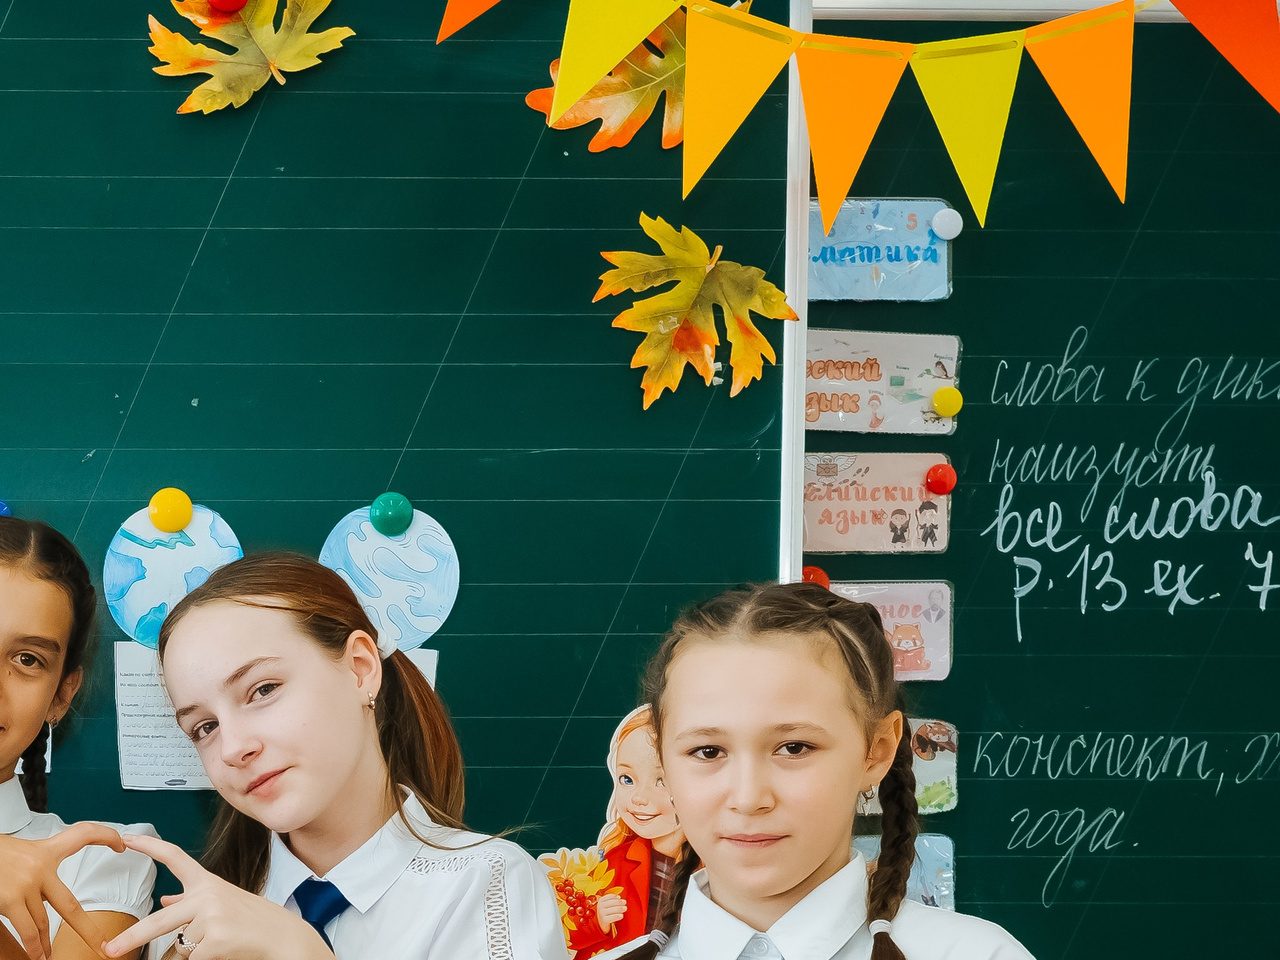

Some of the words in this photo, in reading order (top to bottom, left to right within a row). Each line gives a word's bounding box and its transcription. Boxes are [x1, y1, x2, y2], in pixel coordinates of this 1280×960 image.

[808, 245, 938, 264] матика
[990, 325, 1106, 407] слова
[1125, 357, 1160, 402] к
[1154, 354, 1280, 455] дик
[980, 483, 1083, 553] все
[1103, 470, 1280, 544] слова
[988, 438, 1216, 523] наизусть
[817, 507, 888, 535] язык
[874, 603, 923, 619] ное
[1066, 543, 1128, 615] 13
[973, 731, 1224, 797] конспект,
[1007, 806, 1139, 908] года.
